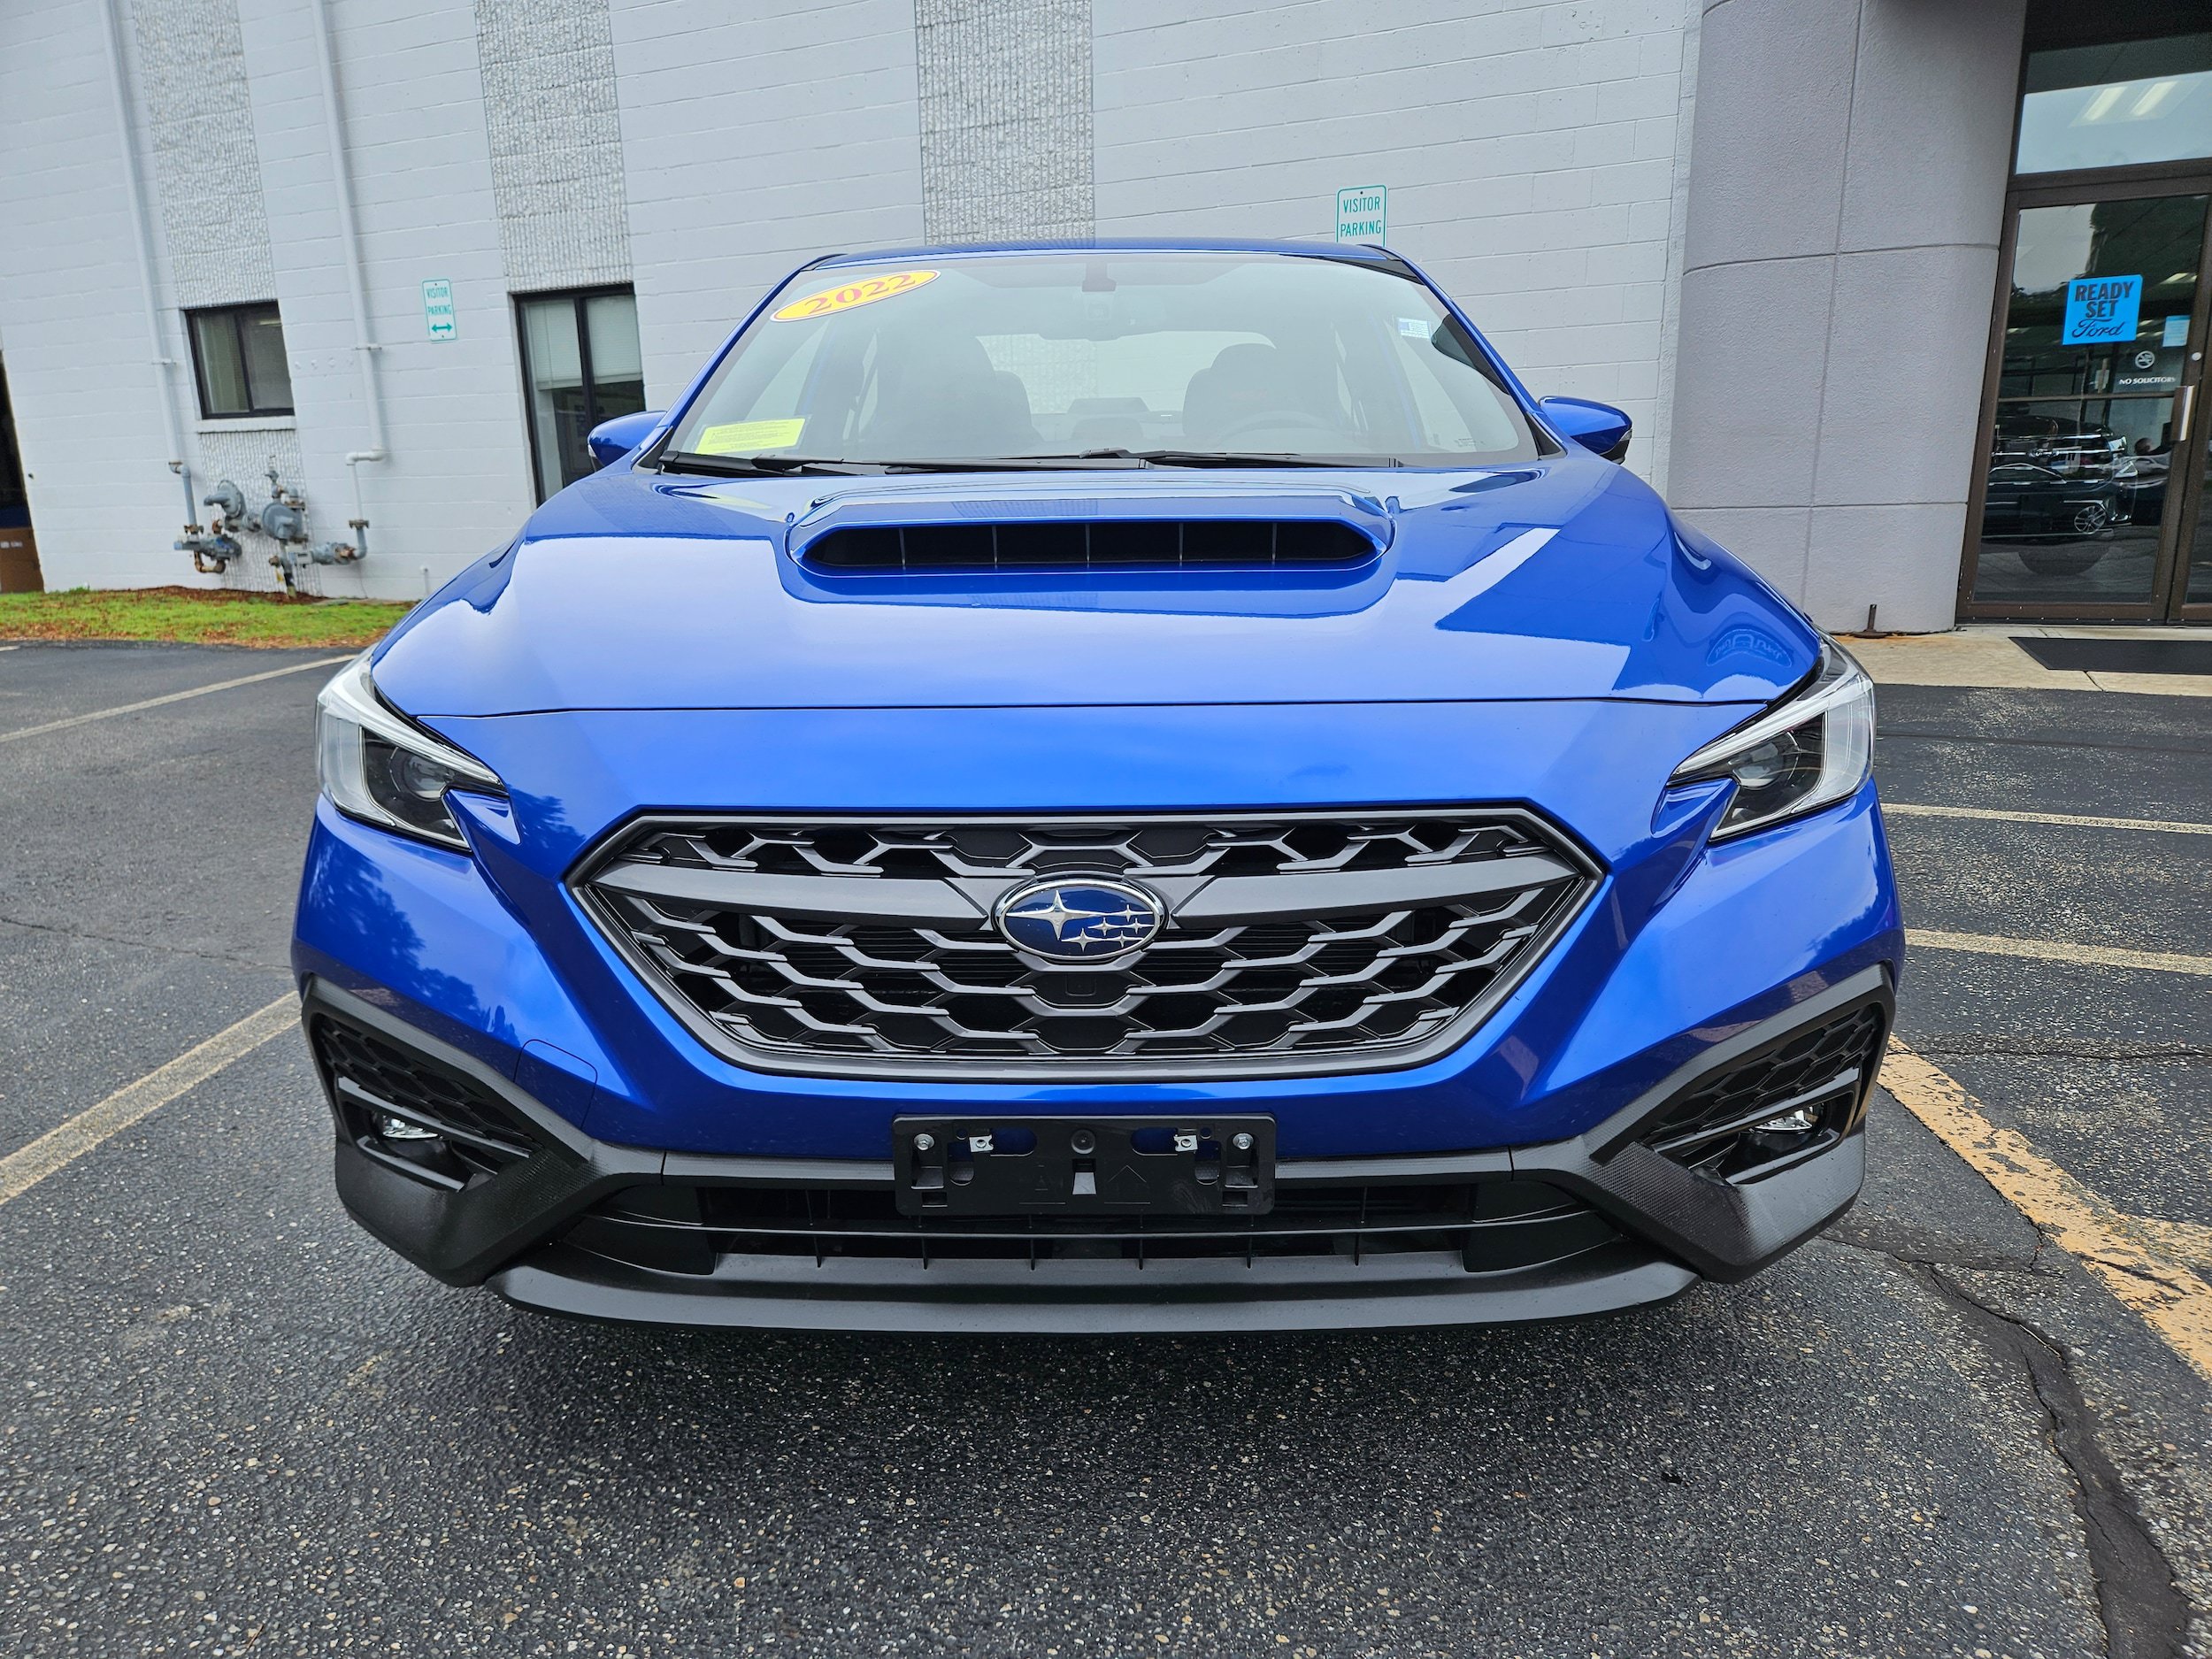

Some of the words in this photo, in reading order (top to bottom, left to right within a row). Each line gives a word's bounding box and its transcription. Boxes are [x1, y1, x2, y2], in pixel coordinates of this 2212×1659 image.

[1343, 196, 1380, 213] VISITOR
[1340, 219, 1381, 237] PARKING
[426, 288, 448, 298] VISITOR
[804, 274, 915, 314] 2022
[2075, 282, 2133, 302] READY
[427, 304, 450, 315] PARKING
[2085, 300, 2119, 318] SET
[2071, 318, 2126, 338] Ford
[2132, 376, 2176, 385] SOLICITORS
